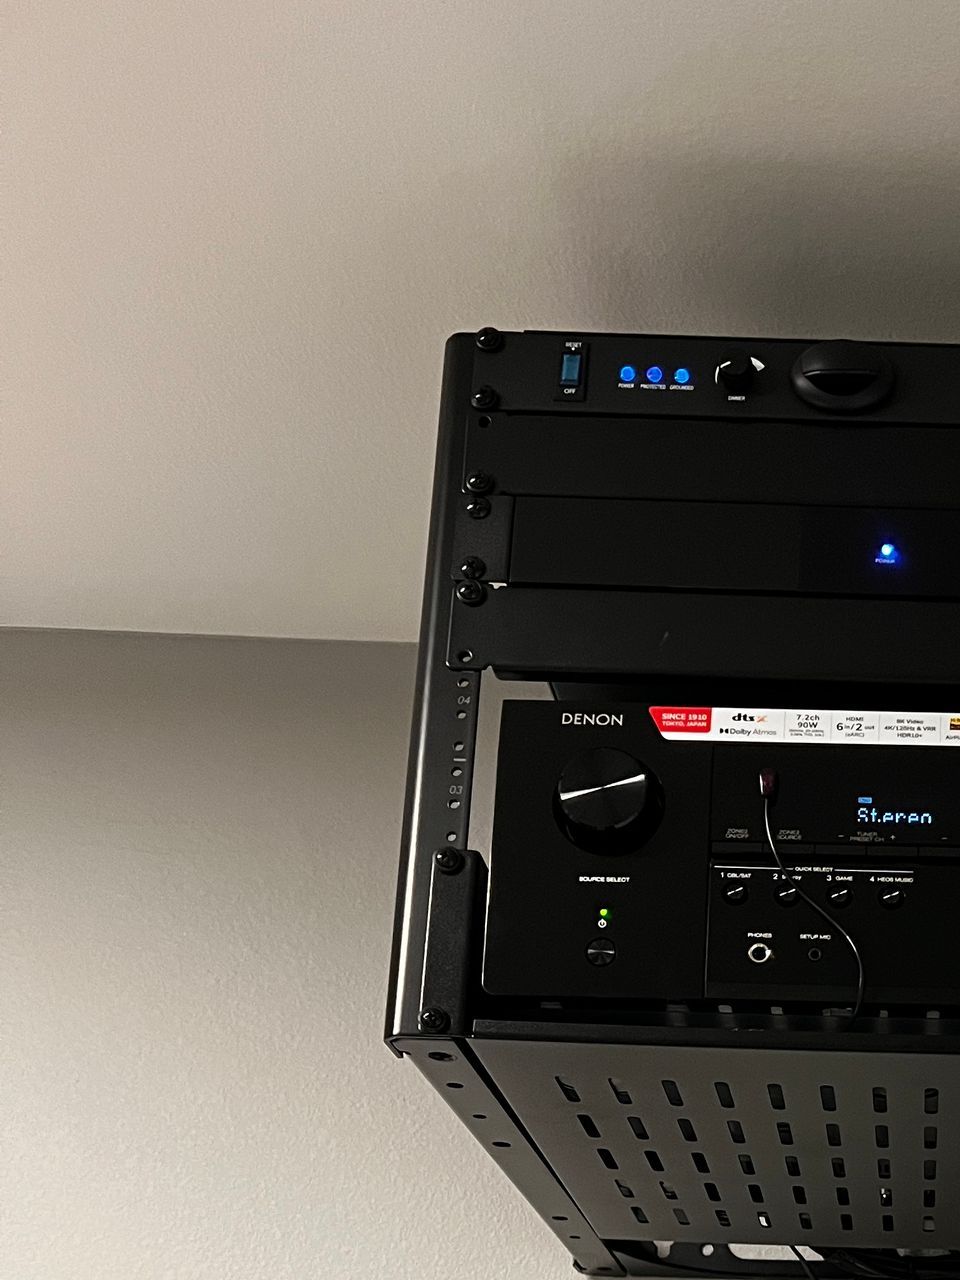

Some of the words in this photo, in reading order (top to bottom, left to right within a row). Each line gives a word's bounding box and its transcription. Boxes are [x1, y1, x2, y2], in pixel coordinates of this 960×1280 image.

[457, 696, 470, 704] 04
[562, 713, 623, 726] DENON
[730, 728, 751, 736] Dolby
[449, 786, 462, 794] 03
